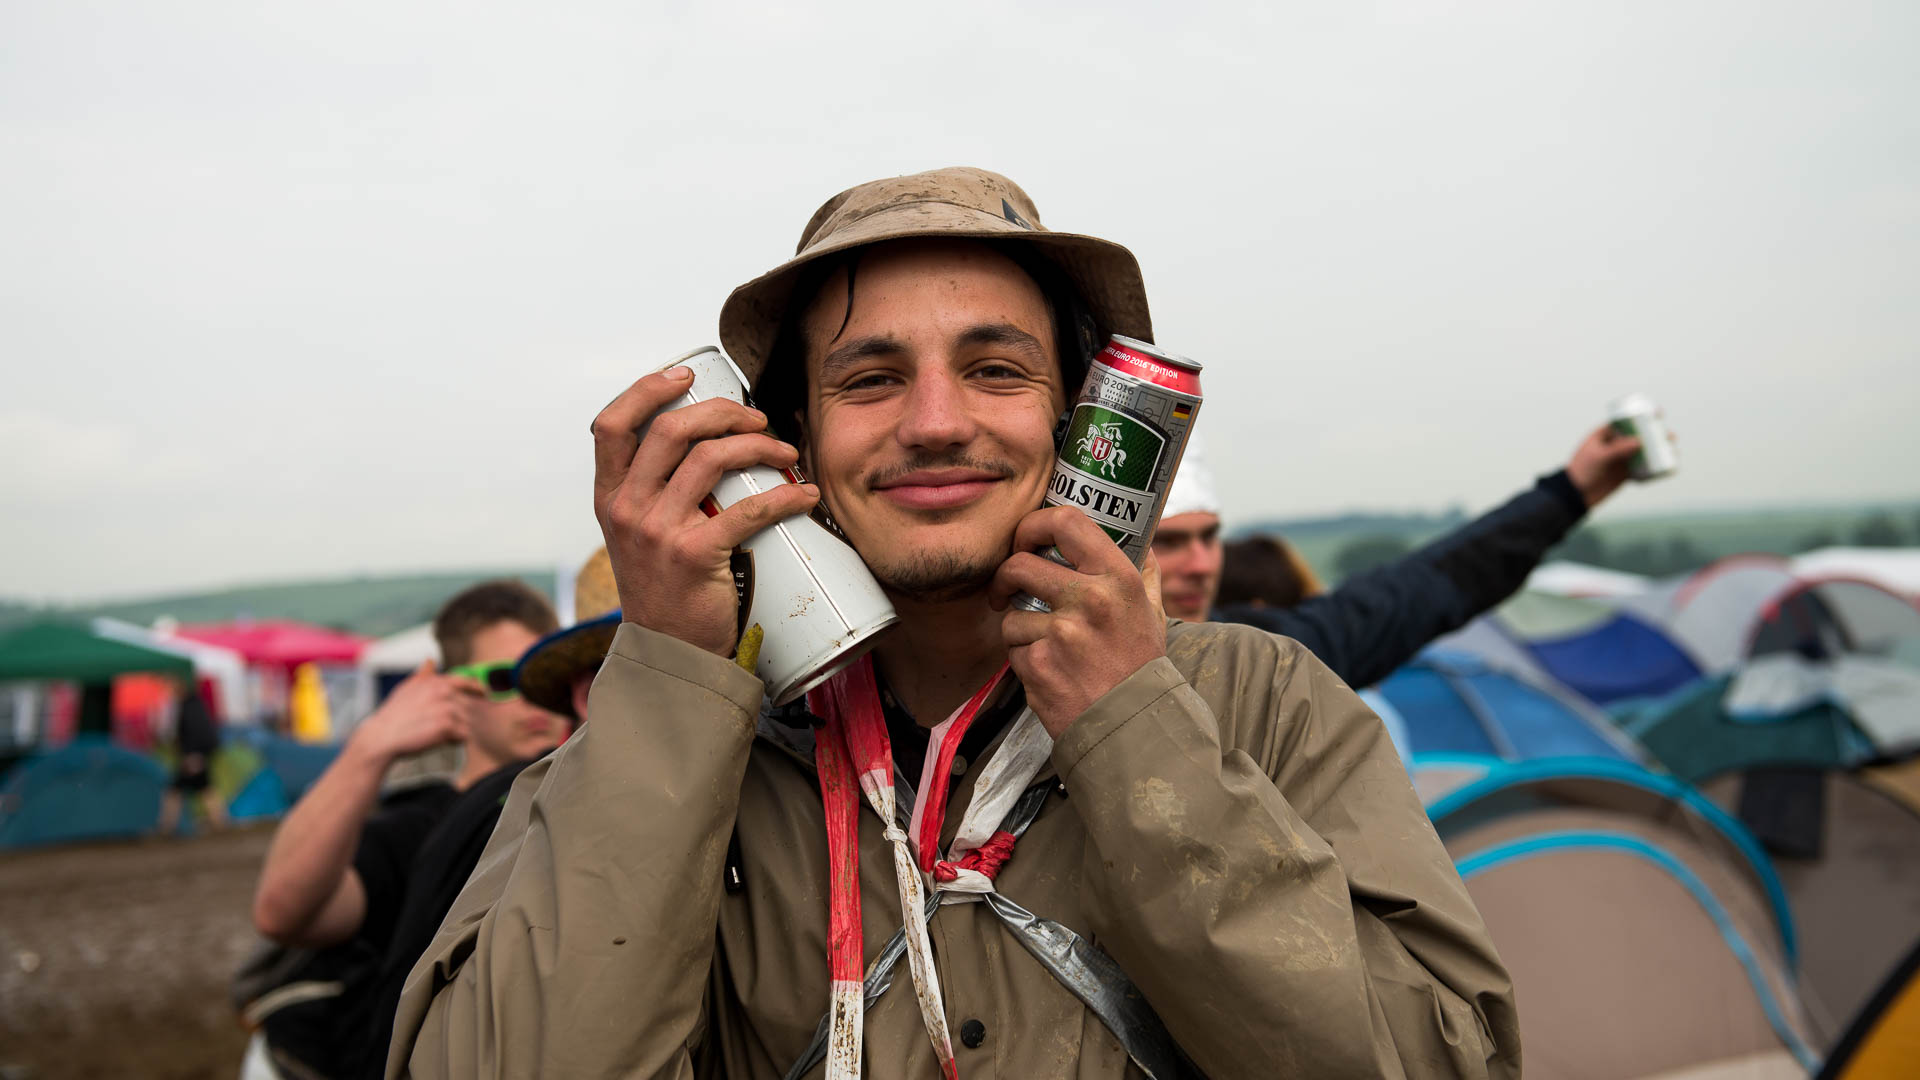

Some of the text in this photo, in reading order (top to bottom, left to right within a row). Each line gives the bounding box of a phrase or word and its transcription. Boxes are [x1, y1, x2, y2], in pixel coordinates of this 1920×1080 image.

[1114, 350, 1131, 362] EURO
[1150, 364, 1178, 379] EDITION
[1092, 371, 1110, 386] EURO
[1110, 380, 1135, 395] 2016
[1094, 439, 1109, 459] H
